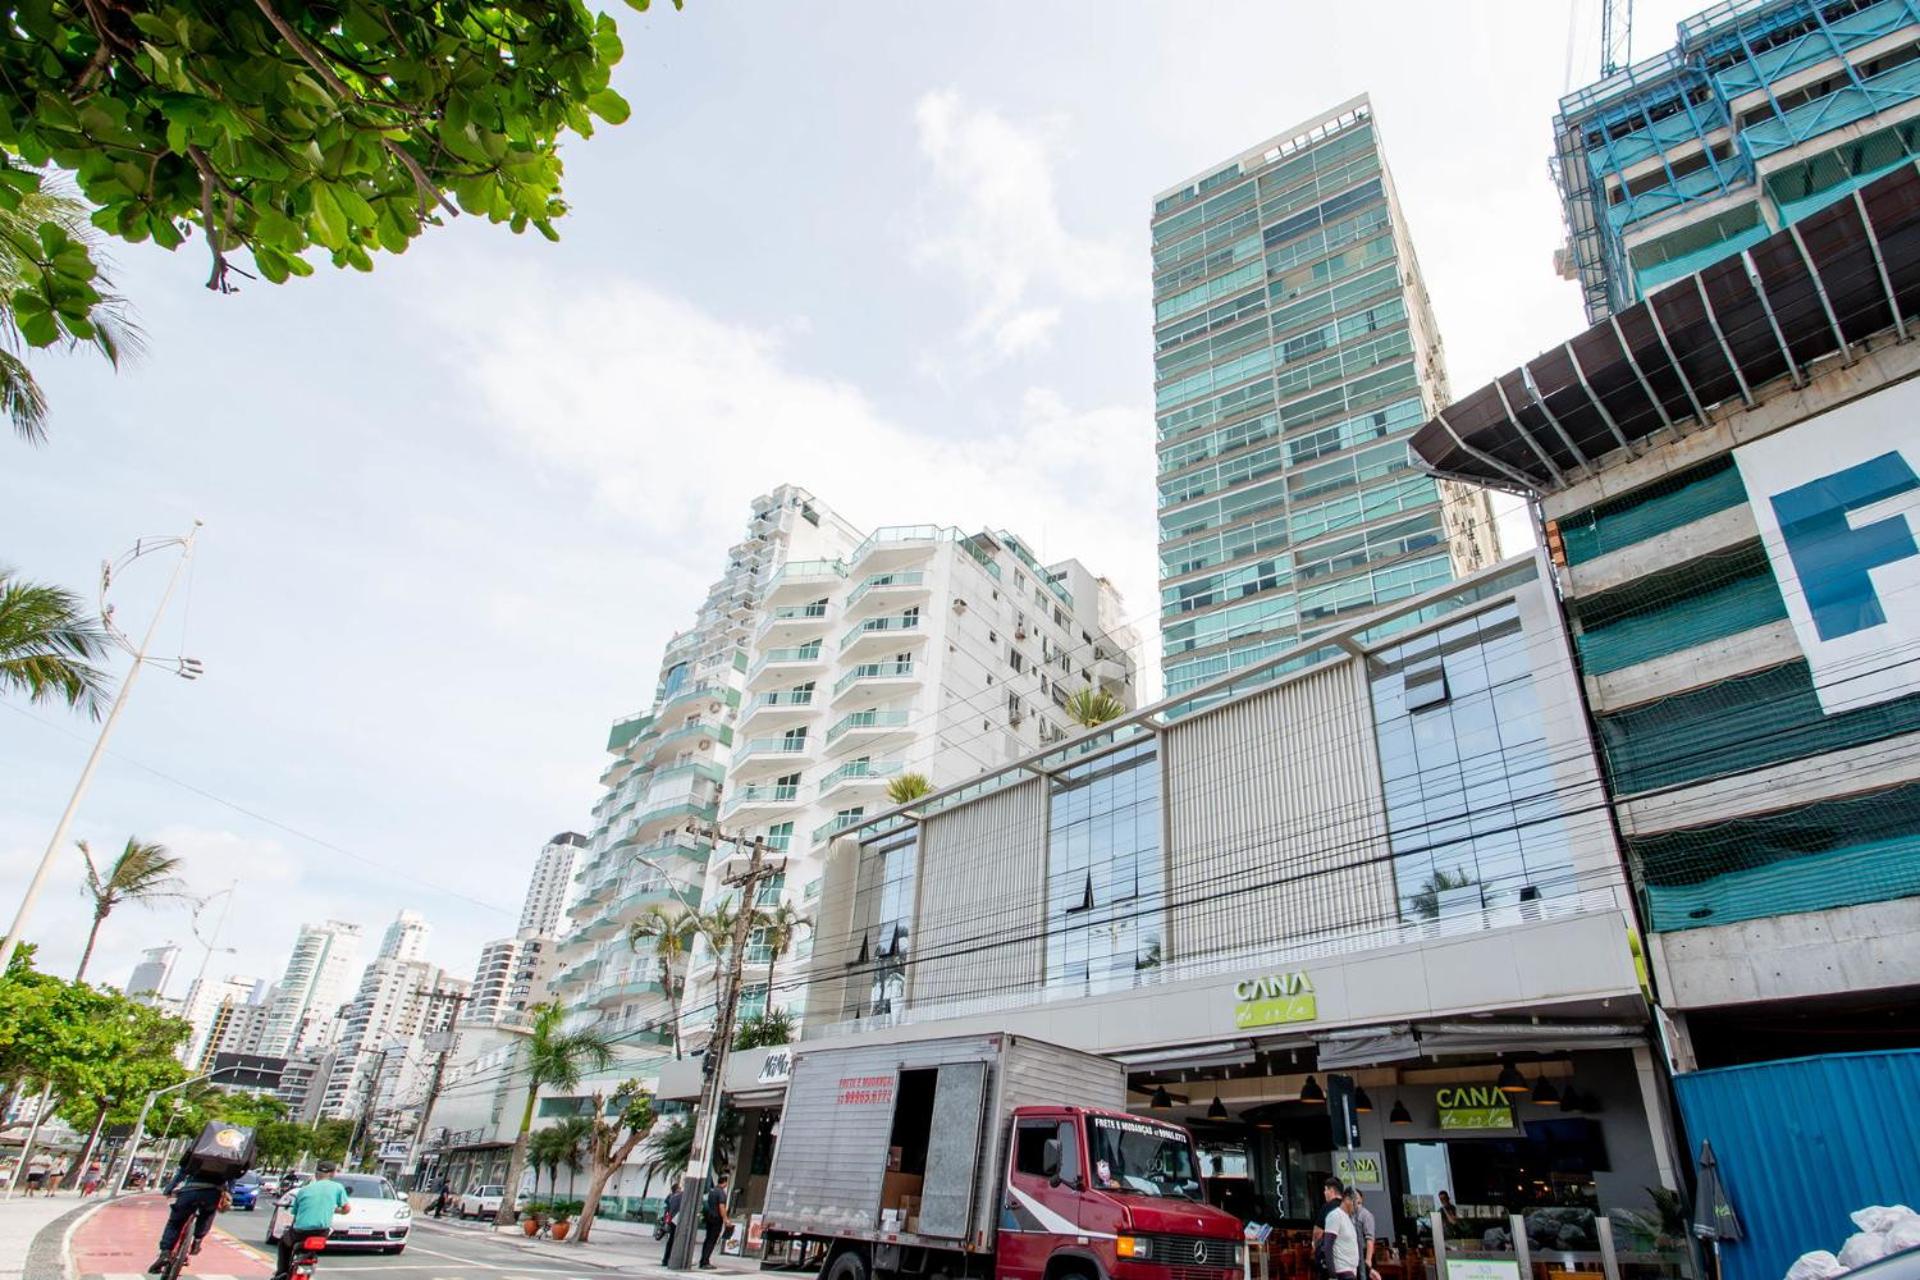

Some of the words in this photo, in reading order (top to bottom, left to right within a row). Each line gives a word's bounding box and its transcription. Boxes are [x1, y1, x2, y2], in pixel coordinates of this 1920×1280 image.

[1233, 970, 1315, 1001] CANA
[1436, 1085, 1510, 1109] CANA
[1095, 1118, 1115, 1129] FRETE
